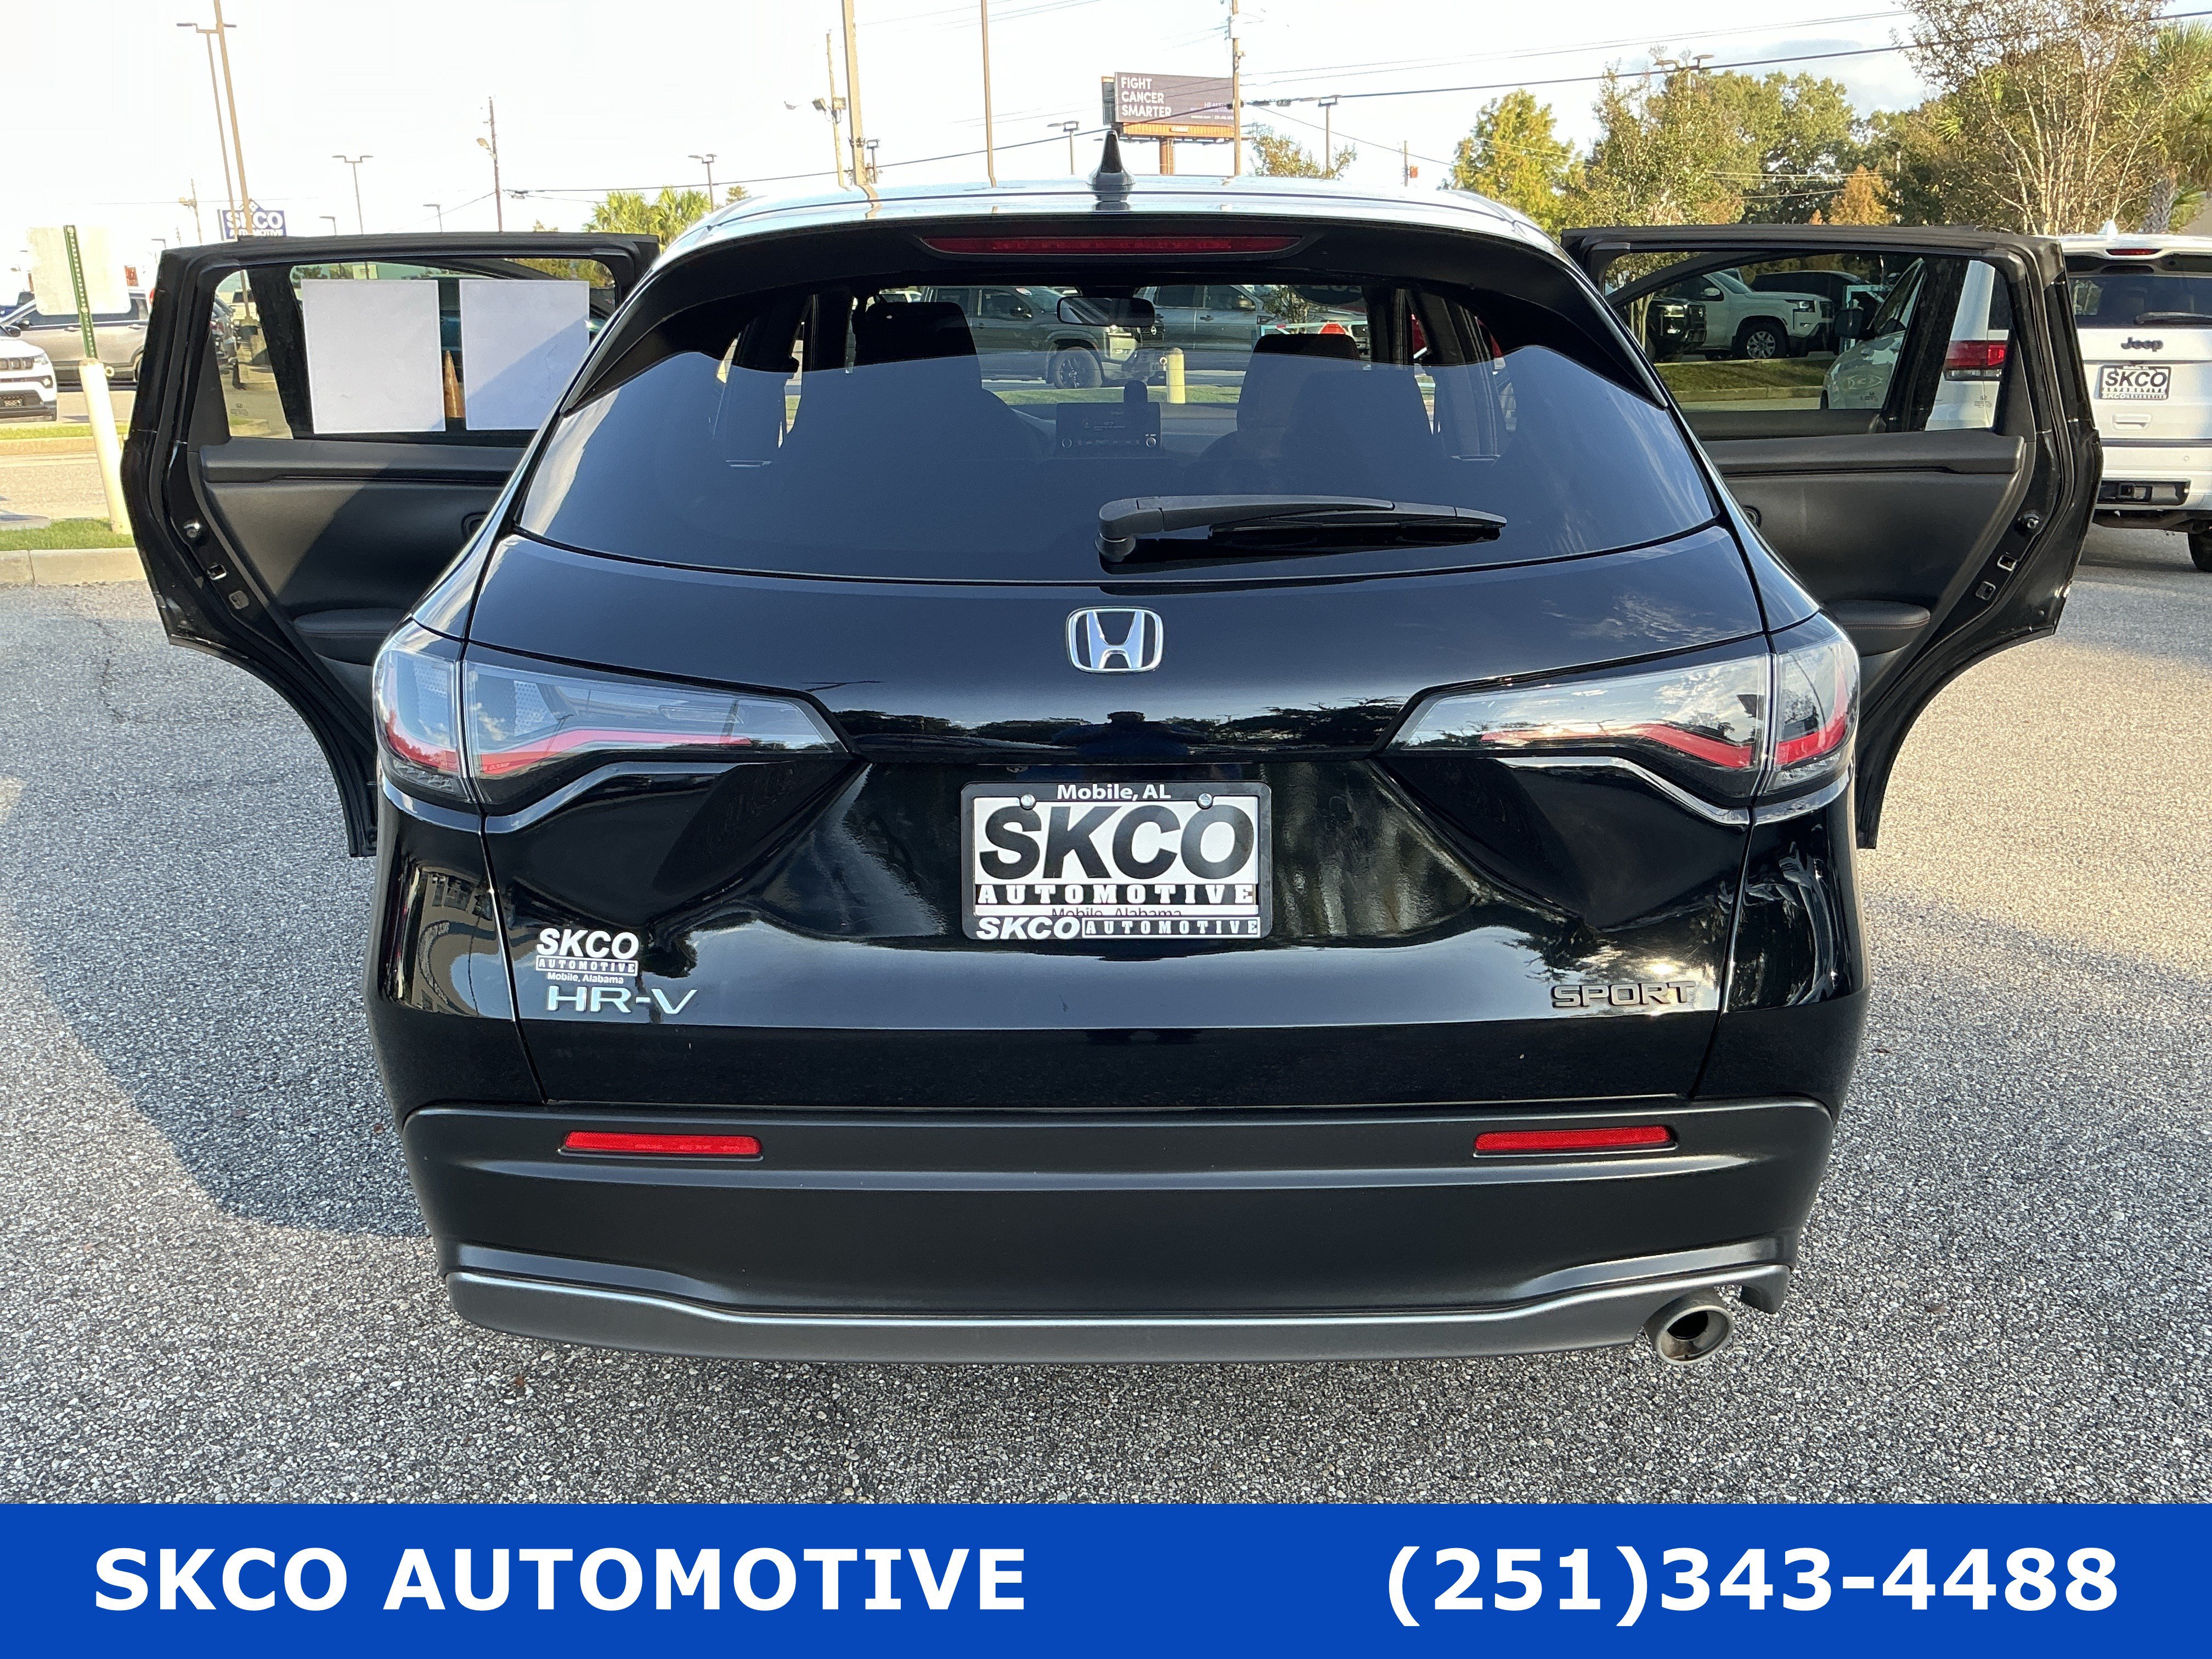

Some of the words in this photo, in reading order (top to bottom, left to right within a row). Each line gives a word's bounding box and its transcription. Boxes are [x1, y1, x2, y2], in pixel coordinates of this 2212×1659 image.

[1121, 77, 1153, 89] FIGHT
[1121, 91, 1165, 104] CANCER
[1121, 104, 1172, 117] SMARTER
[2120, 336, 2164, 353] Jeep
[2104, 371, 2167, 387] SKCO
[1057, 784, 1137, 802] Mobile,
[1142, 784, 1171, 799] AL
[979, 804, 1255, 880] SKCO
[977, 884, 1253, 904] AUTOMOTIVE
[976, 916, 1082, 940] SKCO
[1085, 919, 1258, 936] AUTOMOTIVE
[536, 928, 640, 960] SKCO
[538, 958, 636, 973] AUTOMOTIVE
[547, 972, 580, 983] Mobile,
[582, 974, 624, 984] Alabama
[547, 985, 698, 1015] HR-V
[1551, 980, 1696, 1008] SPORT
